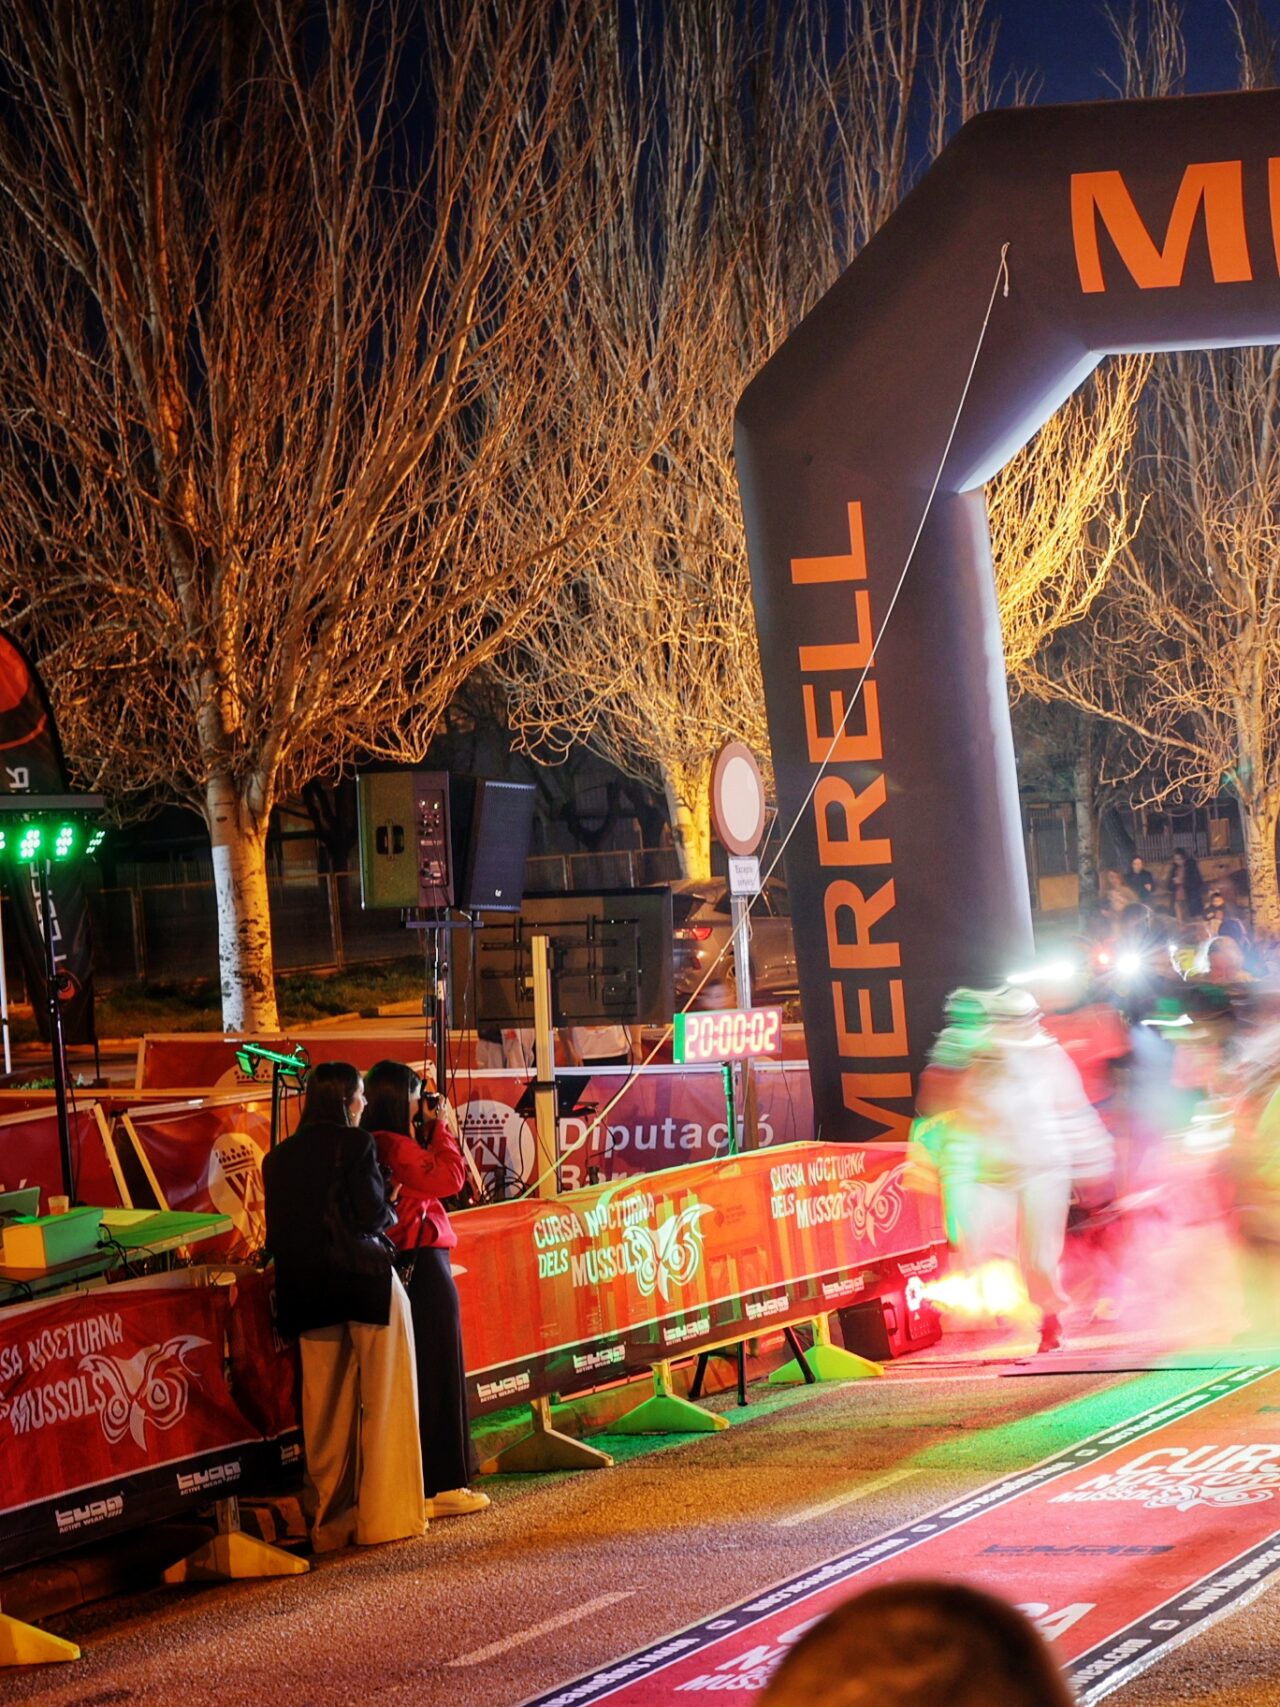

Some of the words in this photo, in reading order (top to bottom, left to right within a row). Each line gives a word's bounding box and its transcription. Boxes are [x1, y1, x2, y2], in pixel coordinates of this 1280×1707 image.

[685, 1010, 779, 1059] 20:00:02
[770, 1163, 806, 1192] CURSA
[807, 1151, 866, 1186] NOCTURNA
[533, 1212, 584, 1249] CURSA
[584, 1192, 655, 1238] NOCTURNA
[771, 1192, 796, 1220] DELS
[537, 1248, 569, 1279] DELS
[571, 1240, 643, 1288] MUSSOLS
[27, 1312, 124, 1373] NOCTURNA
[10, 1368, 106, 1436] MUSSOLS
